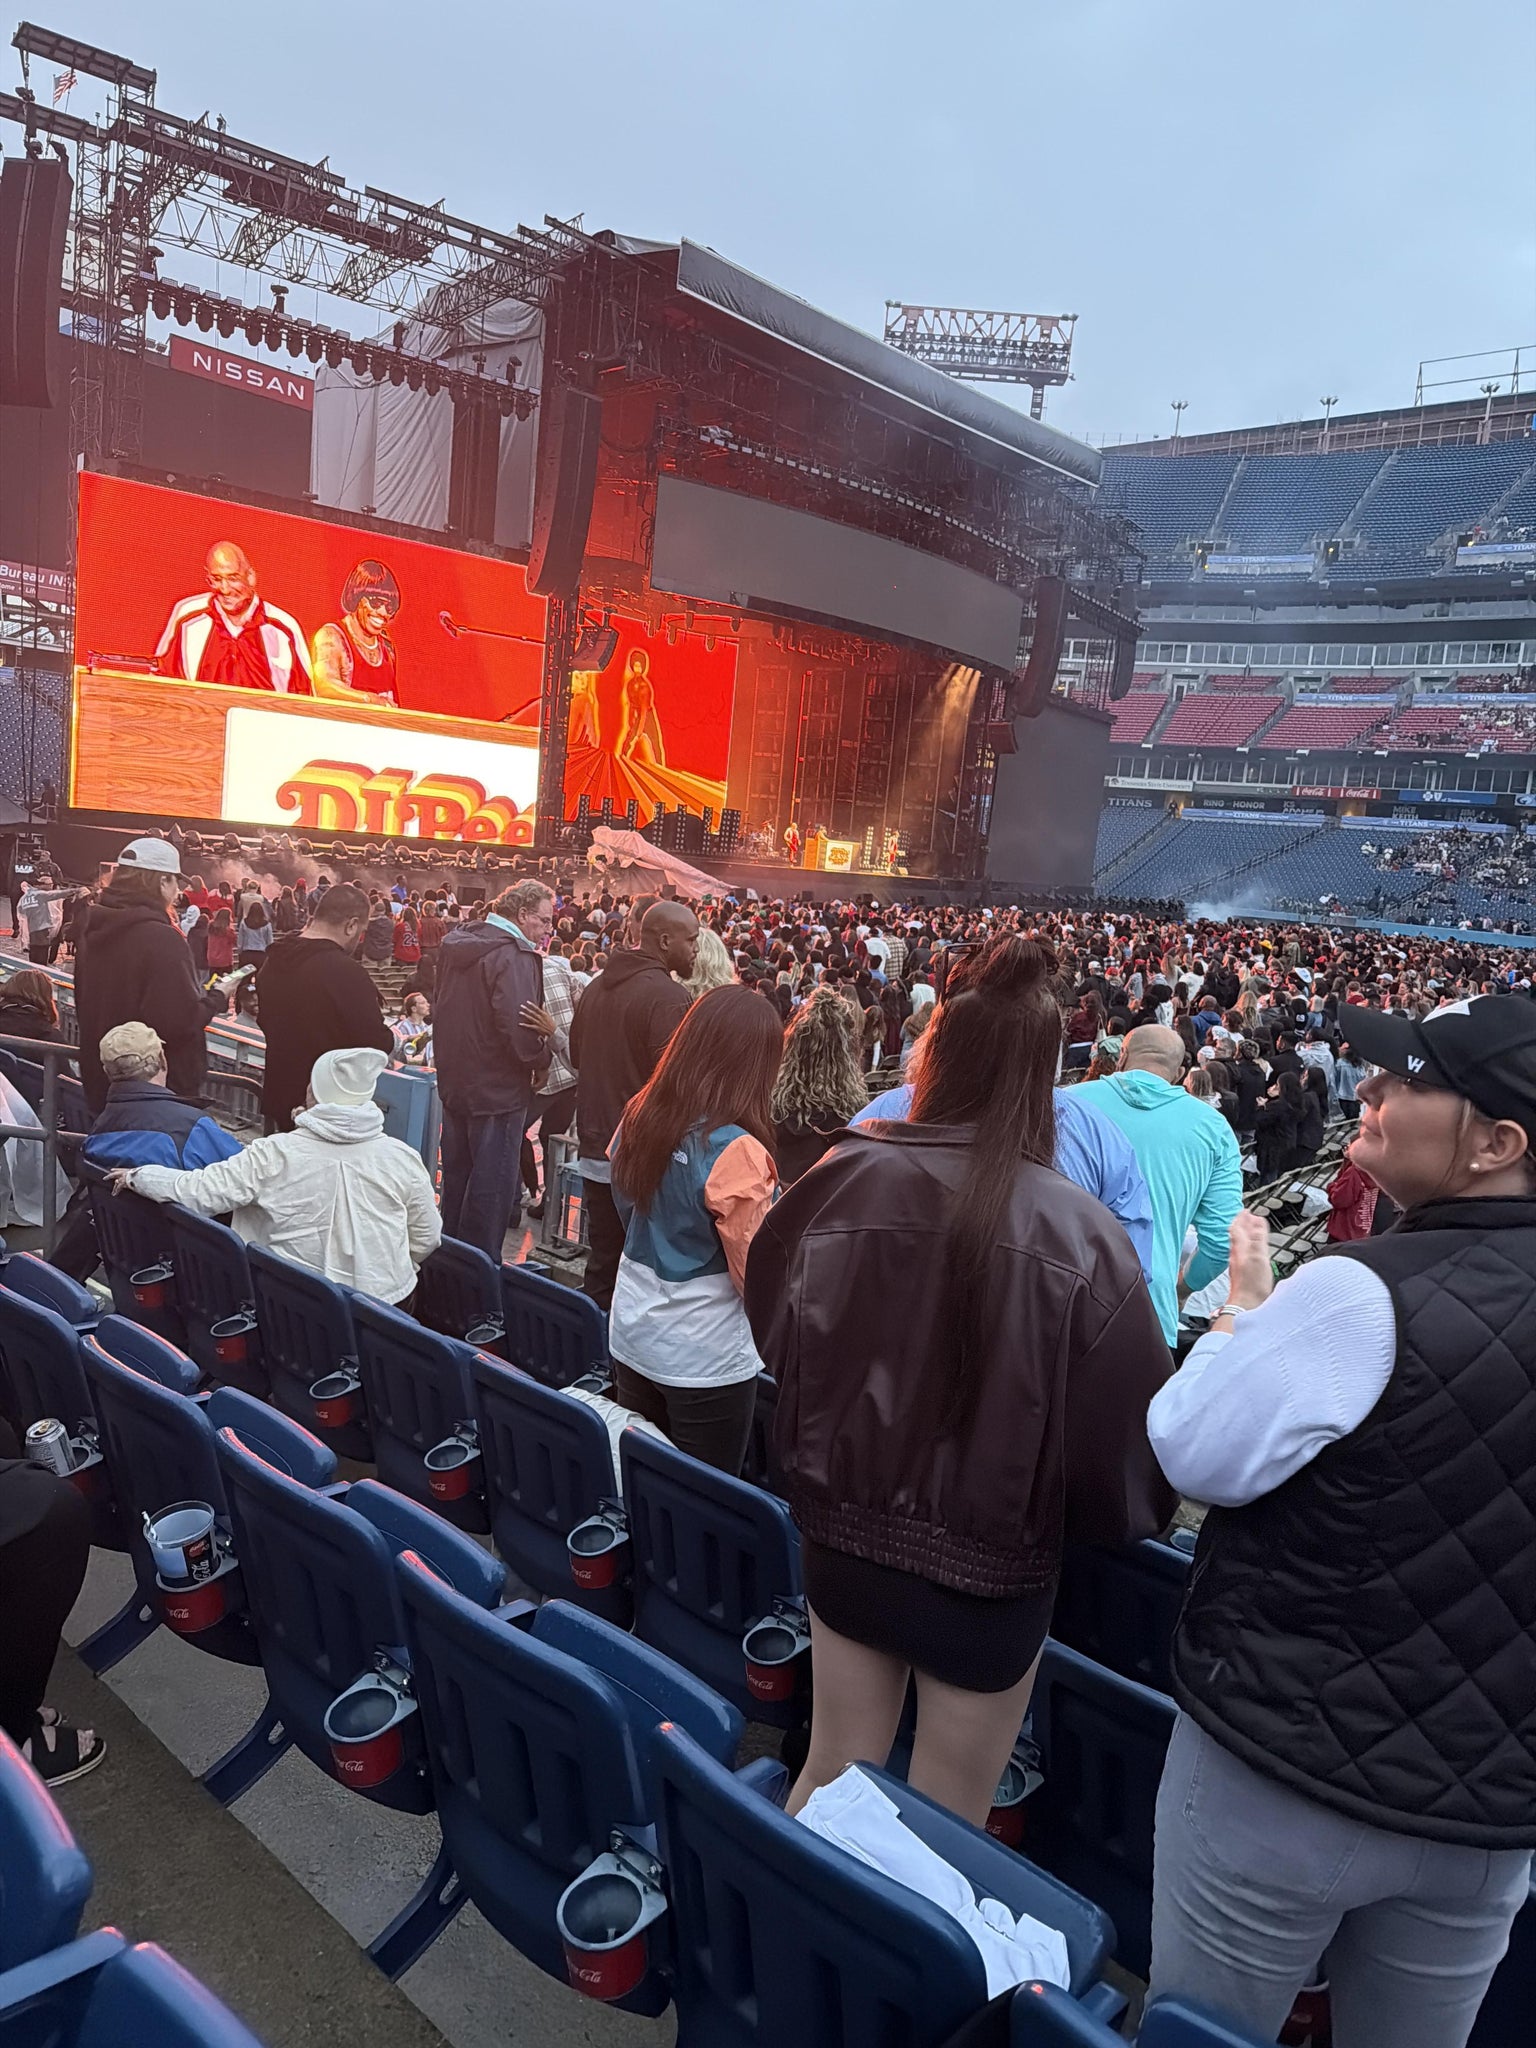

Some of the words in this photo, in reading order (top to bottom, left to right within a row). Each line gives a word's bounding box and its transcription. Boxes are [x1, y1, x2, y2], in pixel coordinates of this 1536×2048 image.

[193, 351, 305, 400] NISSAN
[0, 565, 45, 583] Bureau
[1108, 798, 1152, 807] TITANS
[1232, 801, 1265, 809] HONOR
